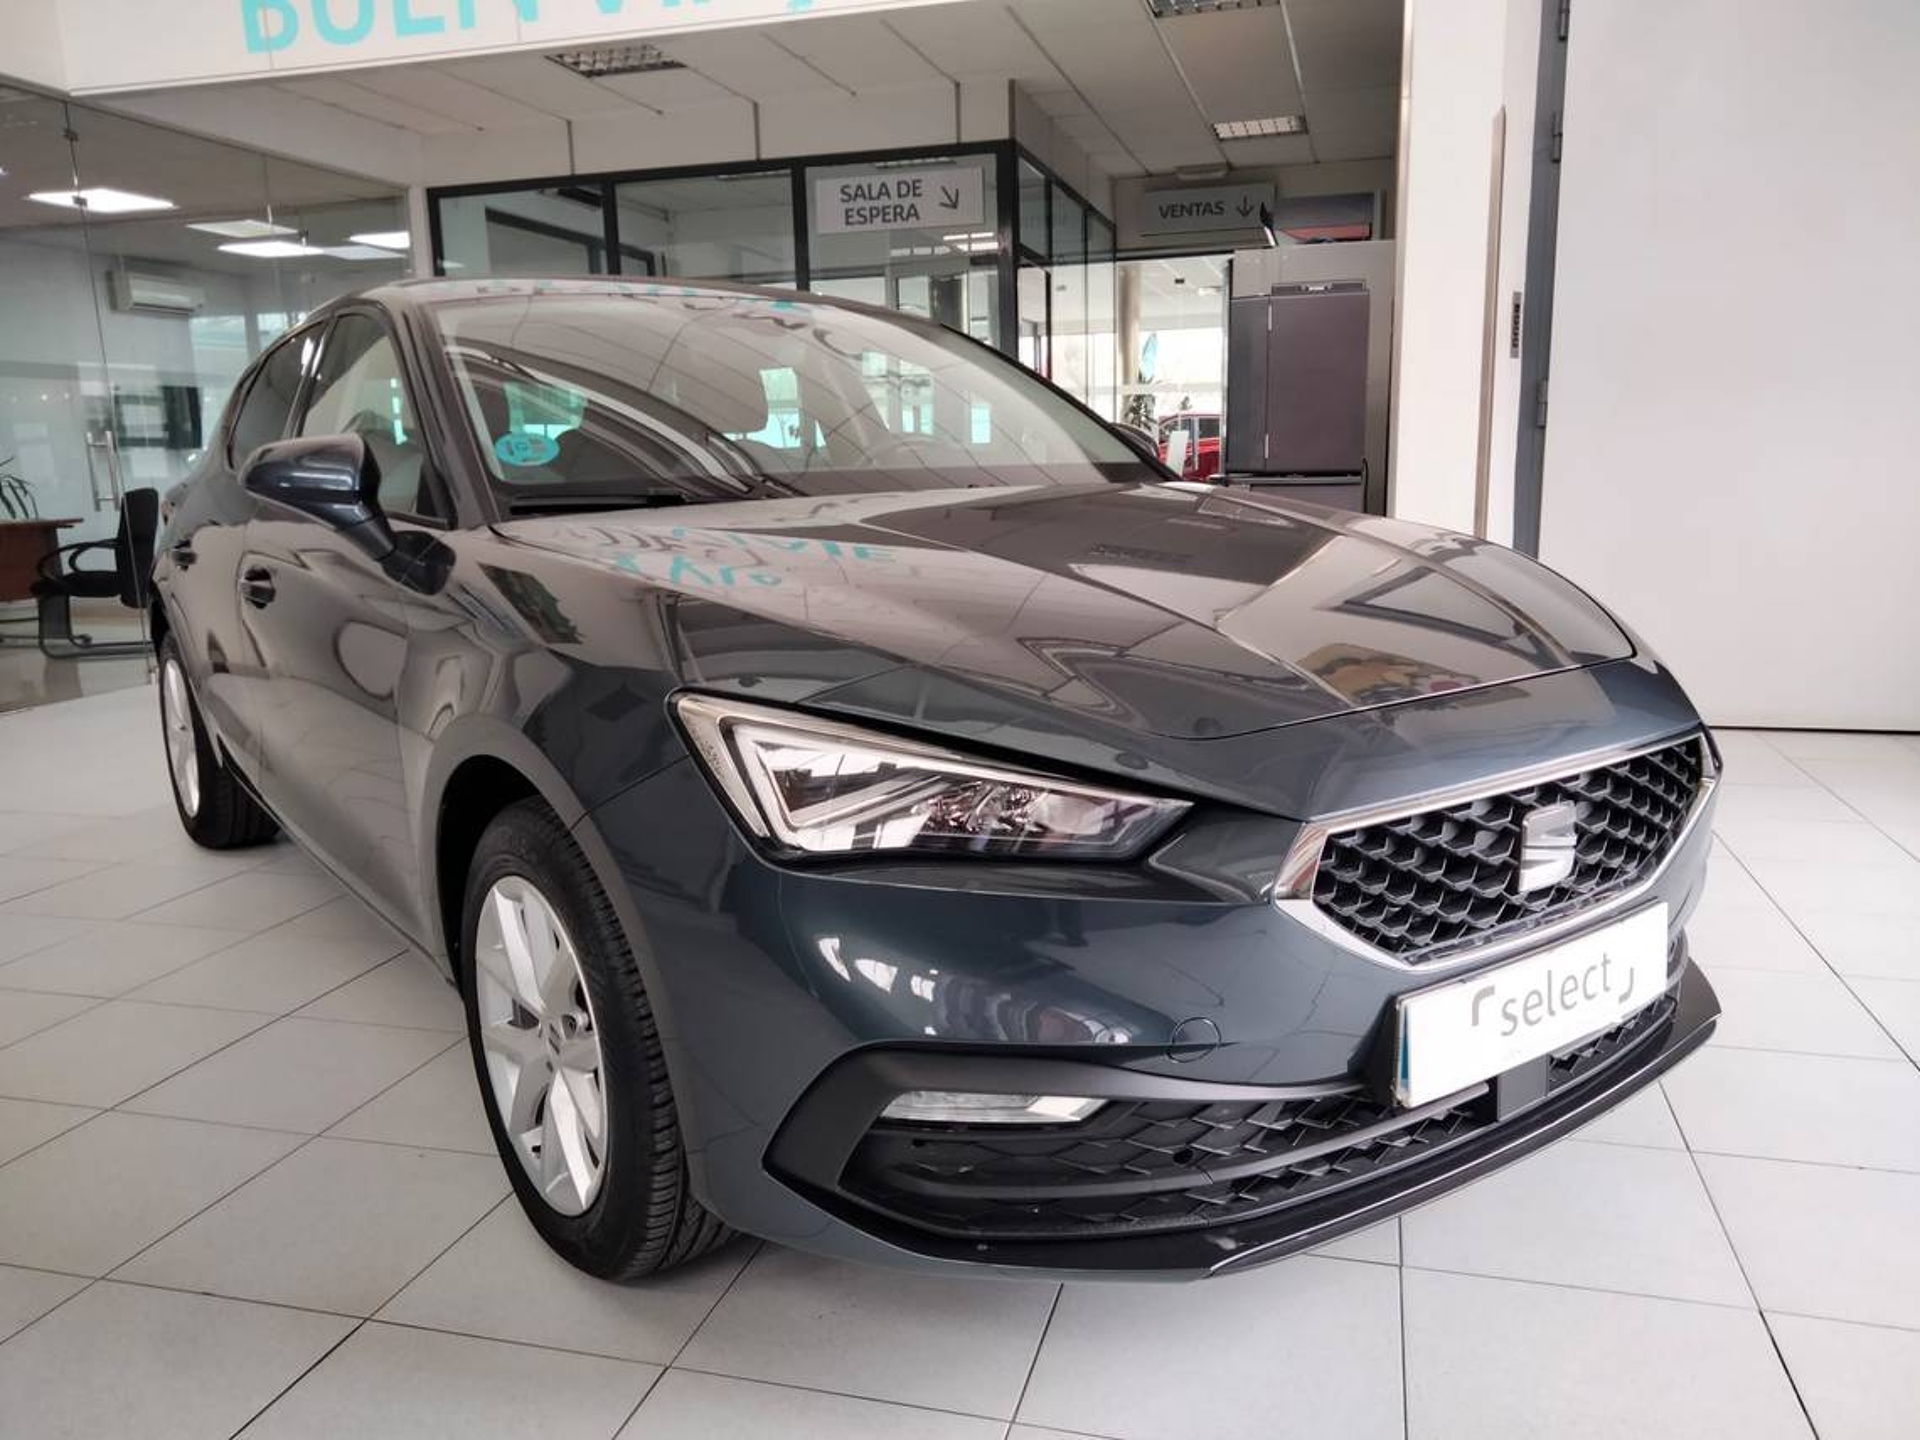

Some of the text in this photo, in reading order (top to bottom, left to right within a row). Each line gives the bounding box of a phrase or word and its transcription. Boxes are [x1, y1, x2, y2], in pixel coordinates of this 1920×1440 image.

[839, 178, 923, 203] SALA DE
[844, 202, 921, 226] ESPERA
[1158, 200, 1226, 219] VENTAS
[1501, 952, 1612, 1037] select
